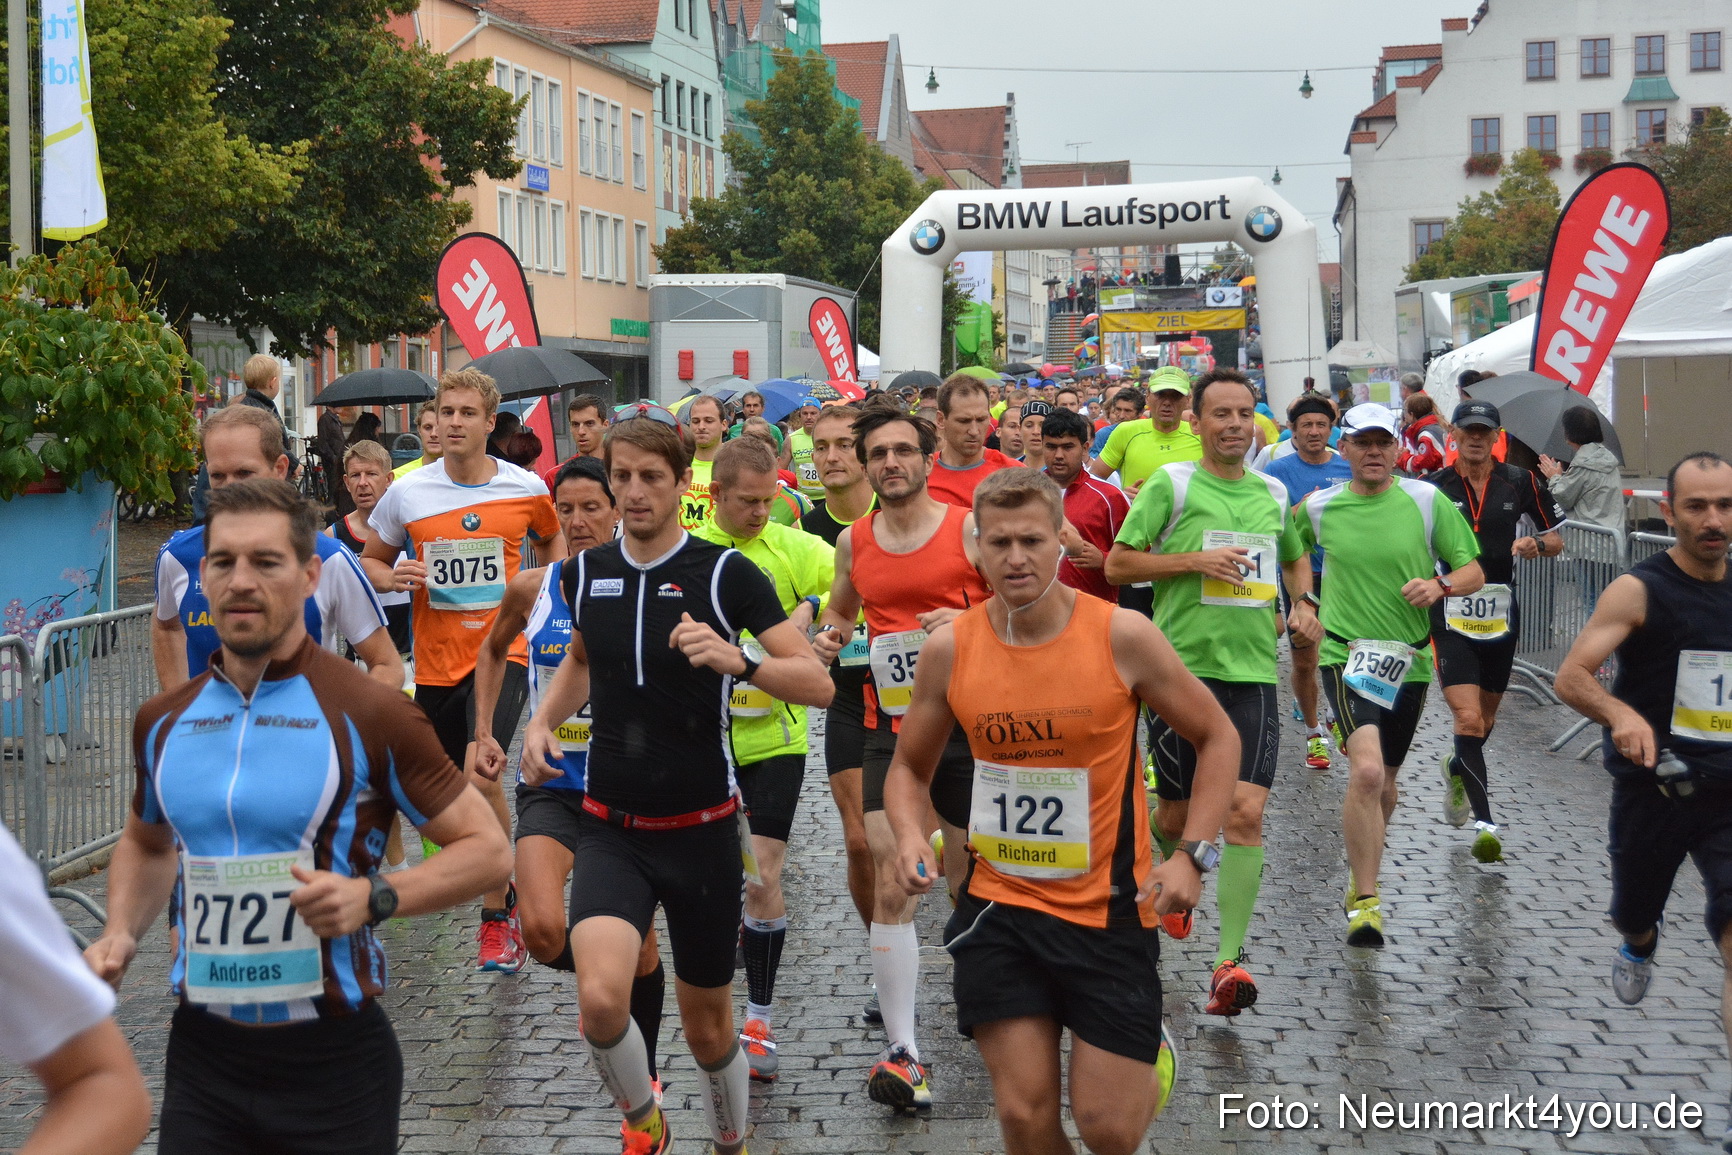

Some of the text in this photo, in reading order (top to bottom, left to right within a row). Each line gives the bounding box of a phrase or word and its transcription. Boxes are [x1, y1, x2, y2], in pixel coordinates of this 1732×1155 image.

[957, 194, 1231, 230] BMW Laufsport
[1543, 194, 1650, 387] REWE
[1156, 315, 1190, 327] ZIEL
[805, 469, 819, 480] 28
[690, 482, 710, 492] ülle
[458, 540, 497, 552] BOCK
[433, 555, 498, 585] 3075
[1233, 585, 1252, 597] Udo
[1460, 597, 1496, 619] 301
[552, 619, 571, 628] HEIT
[1462, 621, 1494, 632] Hartmut
[540, 643, 562, 655] LAC
[1353, 651, 1406, 683] 2590
[1360, 677, 1385, 696] Thomas
[731, 693, 748, 705] vid
[985, 718, 1063, 745] OEXL
[980, 774, 1010, 785] NeuerMarkt
[1016, 771, 1077, 786] BOCK
[992, 792, 1064, 836] 122
[997, 843, 1057, 863] Richard
[193, 891, 297, 945] 2727
[209, 961, 282, 982] Andreas
